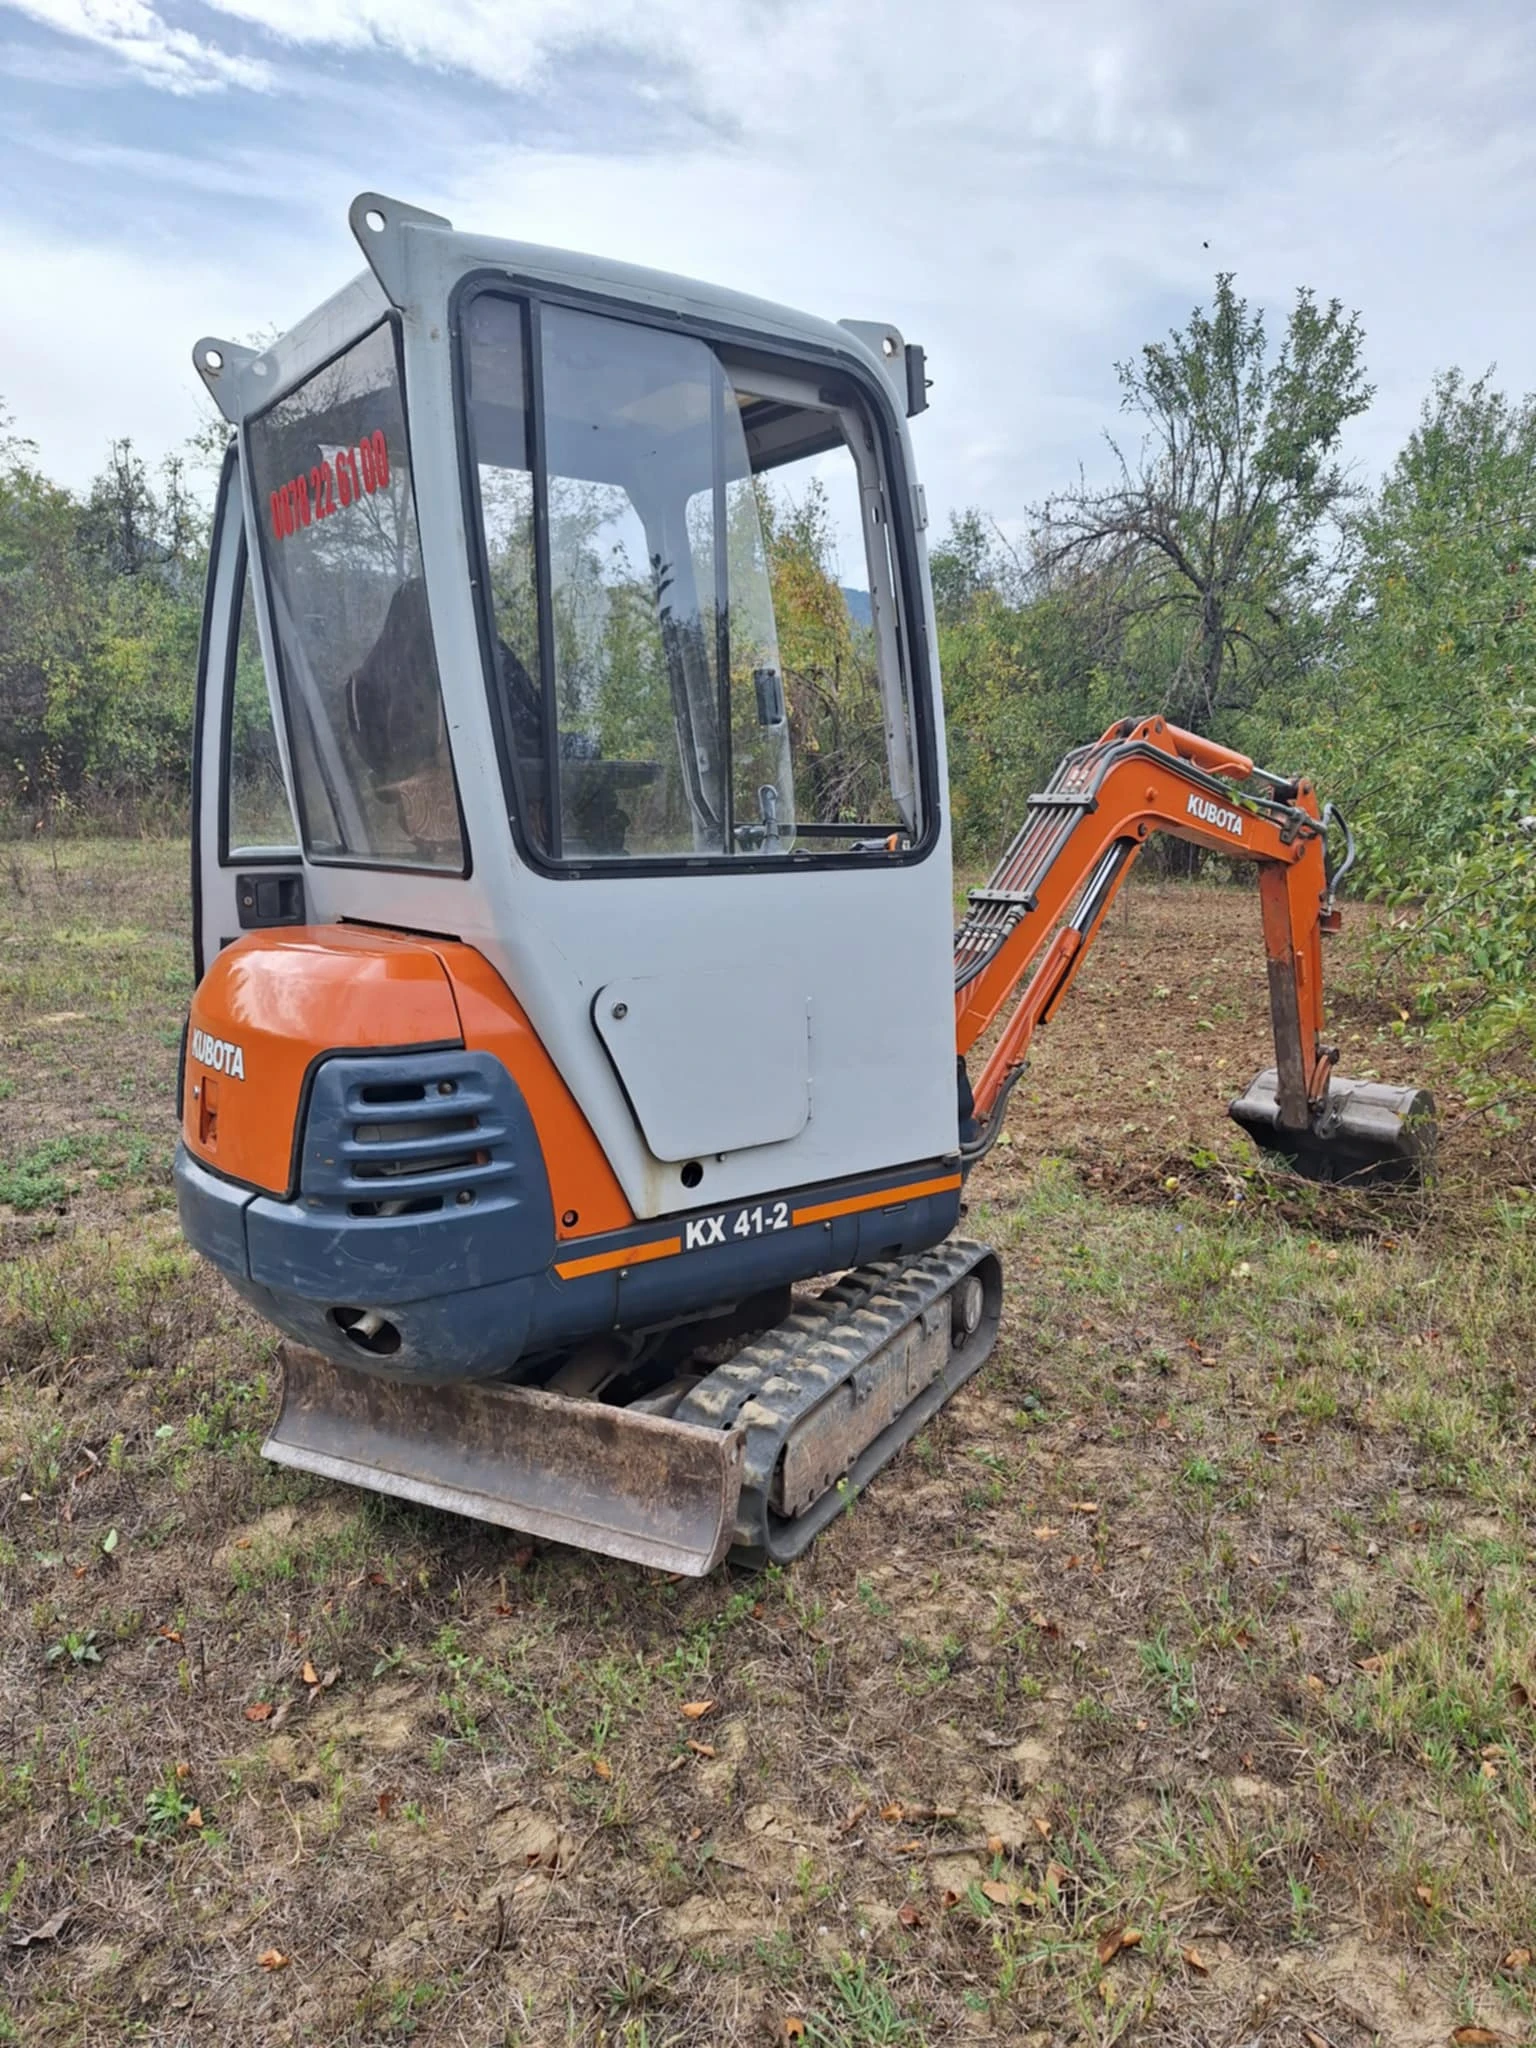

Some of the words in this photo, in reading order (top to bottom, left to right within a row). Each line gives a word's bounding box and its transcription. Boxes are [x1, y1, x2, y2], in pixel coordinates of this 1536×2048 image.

[310, 461, 337, 520] 22
[335, 444, 361, 507] 61
[359, 429, 390, 495] 00
[1187, 794, 1243, 836] KUBOTA
[191, 1027, 245, 1081] KUBOTA
[686, 1214, 726, 1250] KX
[733, 1202, 789, 1237] 41-2
